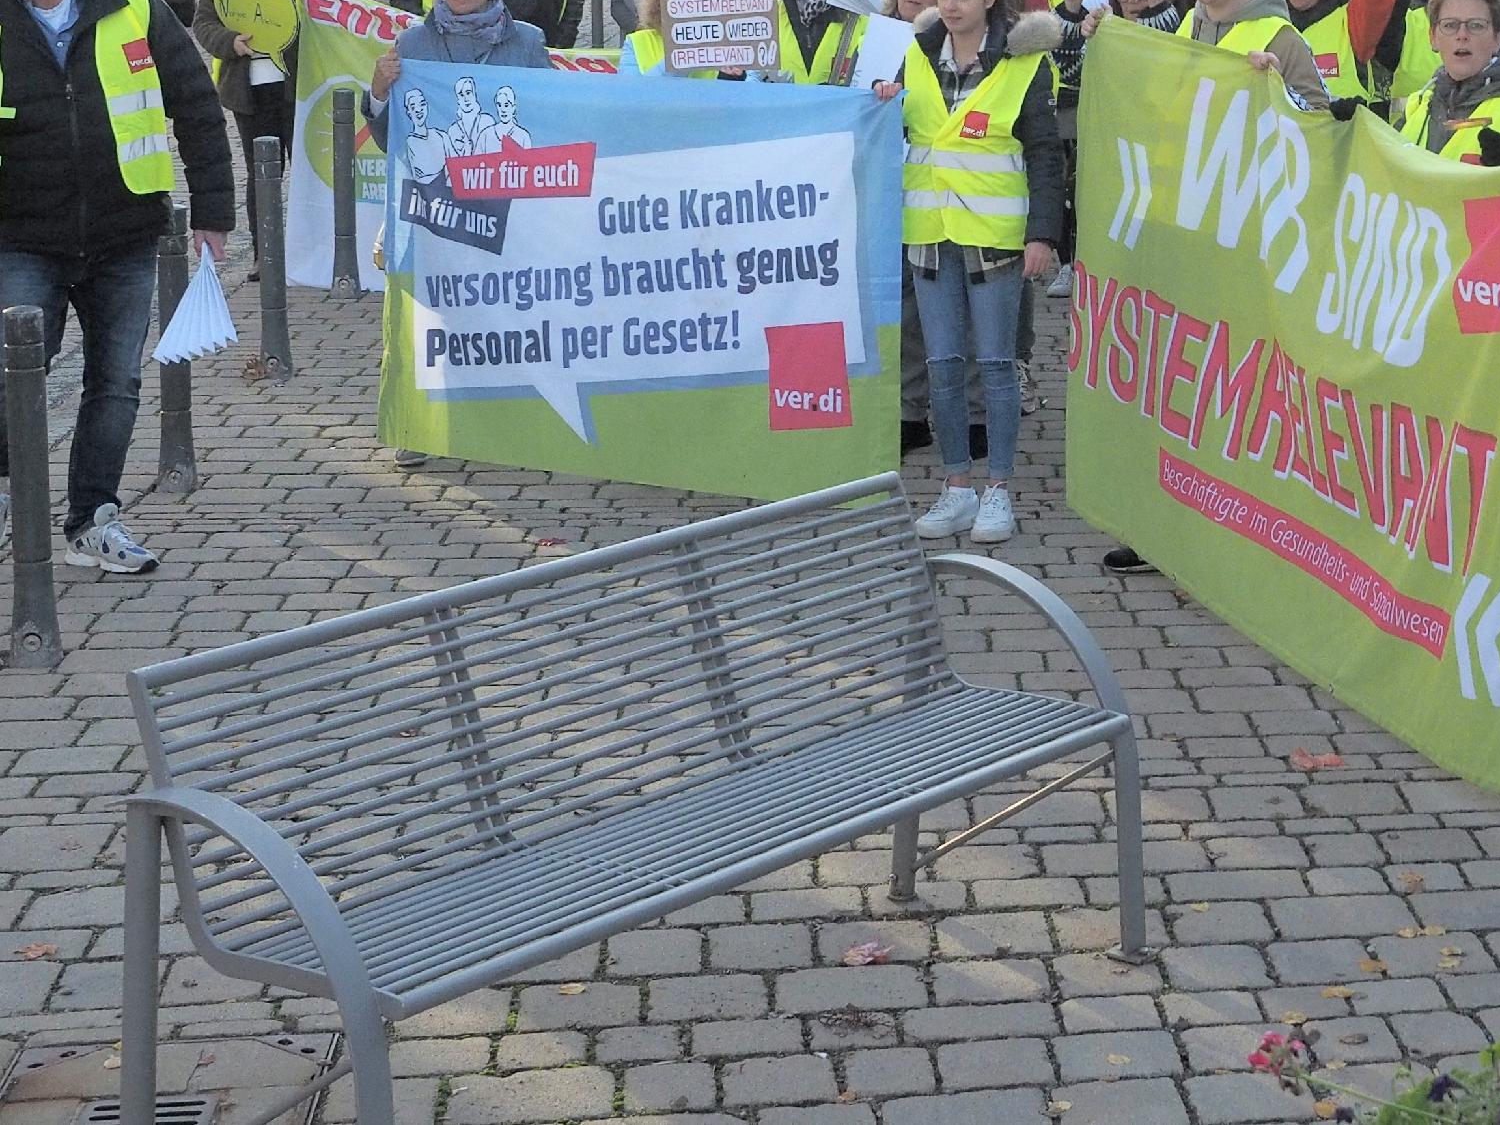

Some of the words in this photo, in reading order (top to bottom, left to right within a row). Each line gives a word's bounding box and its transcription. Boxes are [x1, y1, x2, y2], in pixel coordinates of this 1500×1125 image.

[673, 47, 752, 65] IRRELEVANT
[675, 24, 720, 41] HEUTE
[727, 21, 769, 38] WIEDER
[462, 167, 493, 190] wir
[498, 162, 530, 189] für
[533, 159, 579, 188] euch
[1176, 76, 1311, 294] WIR
[430, 196, 461, 229] für
[465, 211, 498, 238] uns
[598, 192, 669, 236] Gute
[679, 180, 830, 230] Kranken-
[426, 260, 593, 311] versorgung
[601, 248, 728, 296] braucht
[736, 239, 839, 295] genug
[1315, 173, 1453, 367] SIND
[426, 320, 551, 367] Personal
[562, 324, 614, 369] per
[623, 310, 740, 355] Gesetz!
[774, 387, 843, 414] ver.di
[1163, 458, 1248, 525] Beschäftigte
[1249, 511, 1267, 536] im
[1270, 518, 1350, 584] Gesundheits-
[1350, 569, 1369, 599] und
[1368, 578, 1445, 647] Sozialwesen
